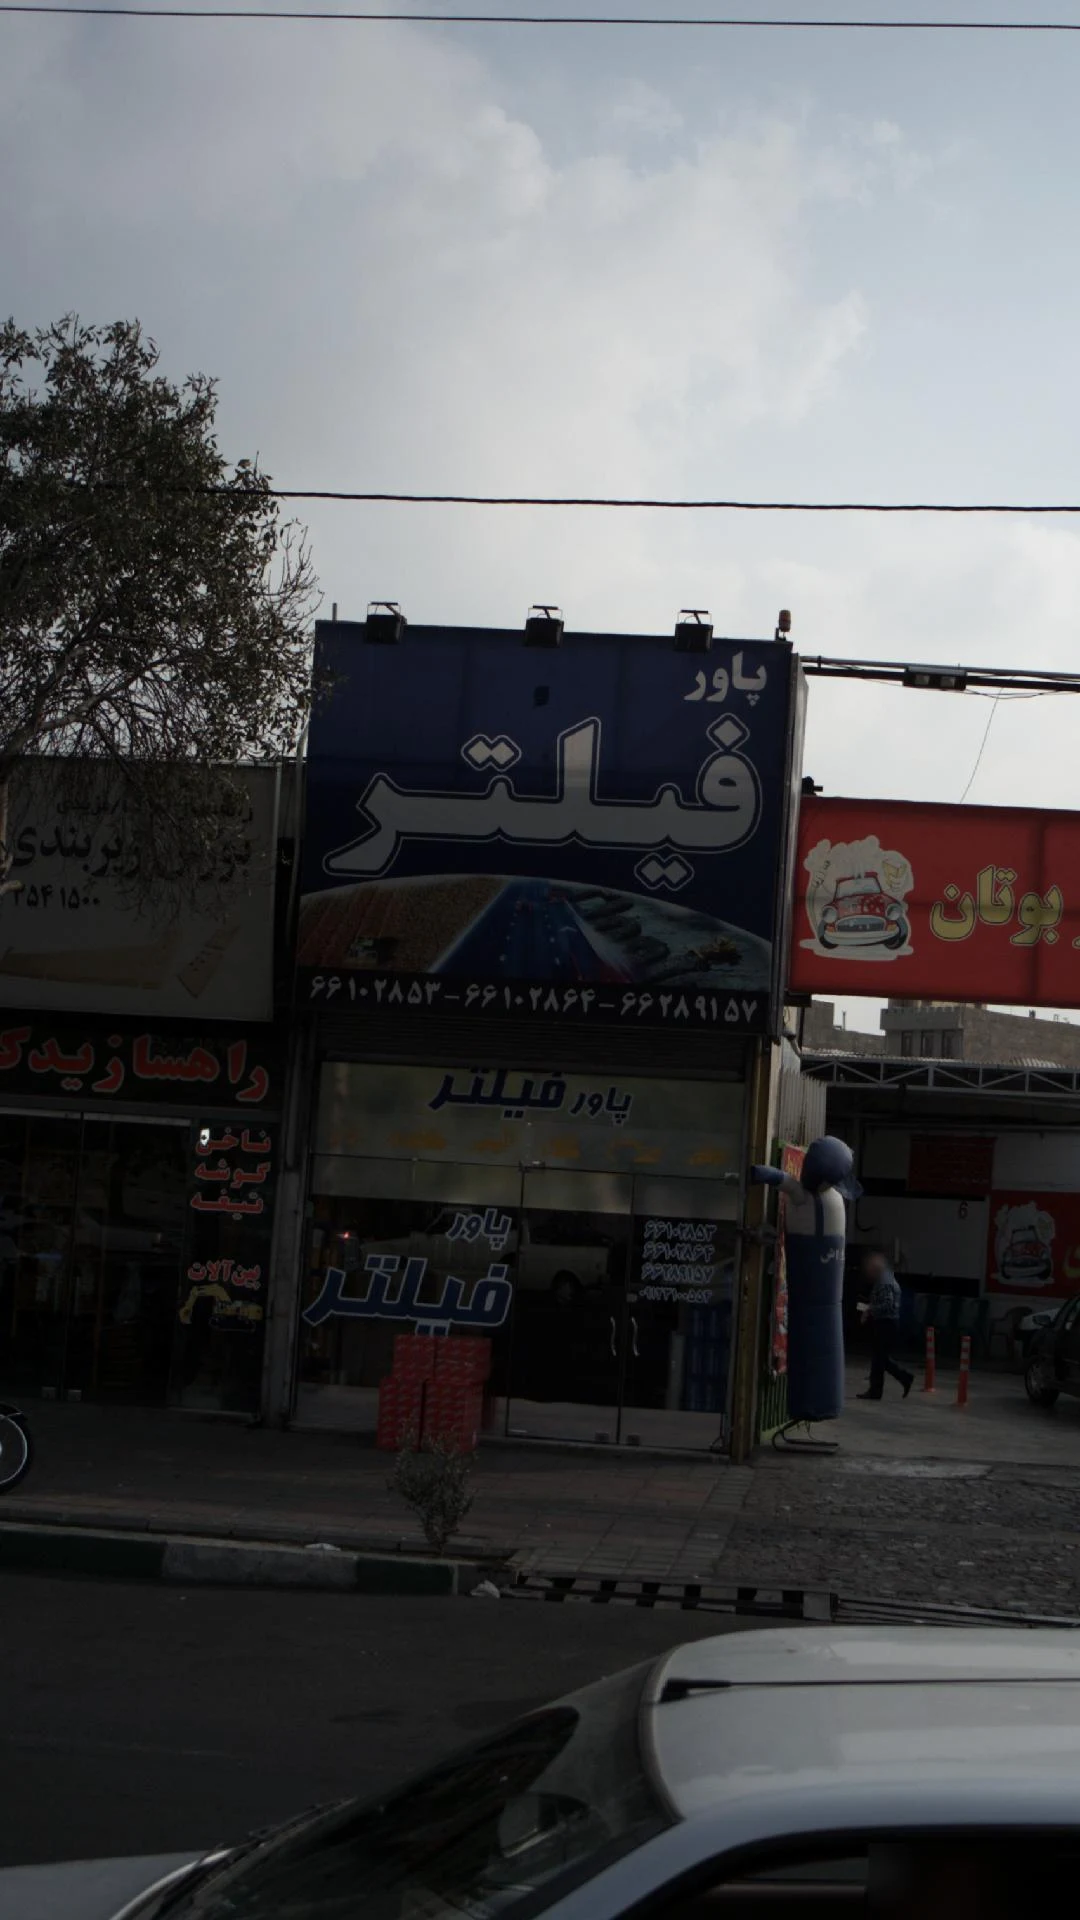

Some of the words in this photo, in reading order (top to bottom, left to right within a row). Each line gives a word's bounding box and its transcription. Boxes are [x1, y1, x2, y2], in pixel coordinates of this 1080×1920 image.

[683, 650, 768, 707] پاور
[322, 712, 762, 891] فیلتر
[930, 864, 1064, 946] بوتان
[91, 1033, 270, 1103] راهساز
[428, 1068, 568, 1119] فیلتر
[570, 1086, 632, 1126] پاور
[195, 1126, 272, 1156] ناخن
[190, 1188, 264, 1221] تیغه
[446, 1207, 512, 1251] پاور
[302, 1253, 512, 1337] فیلتر
